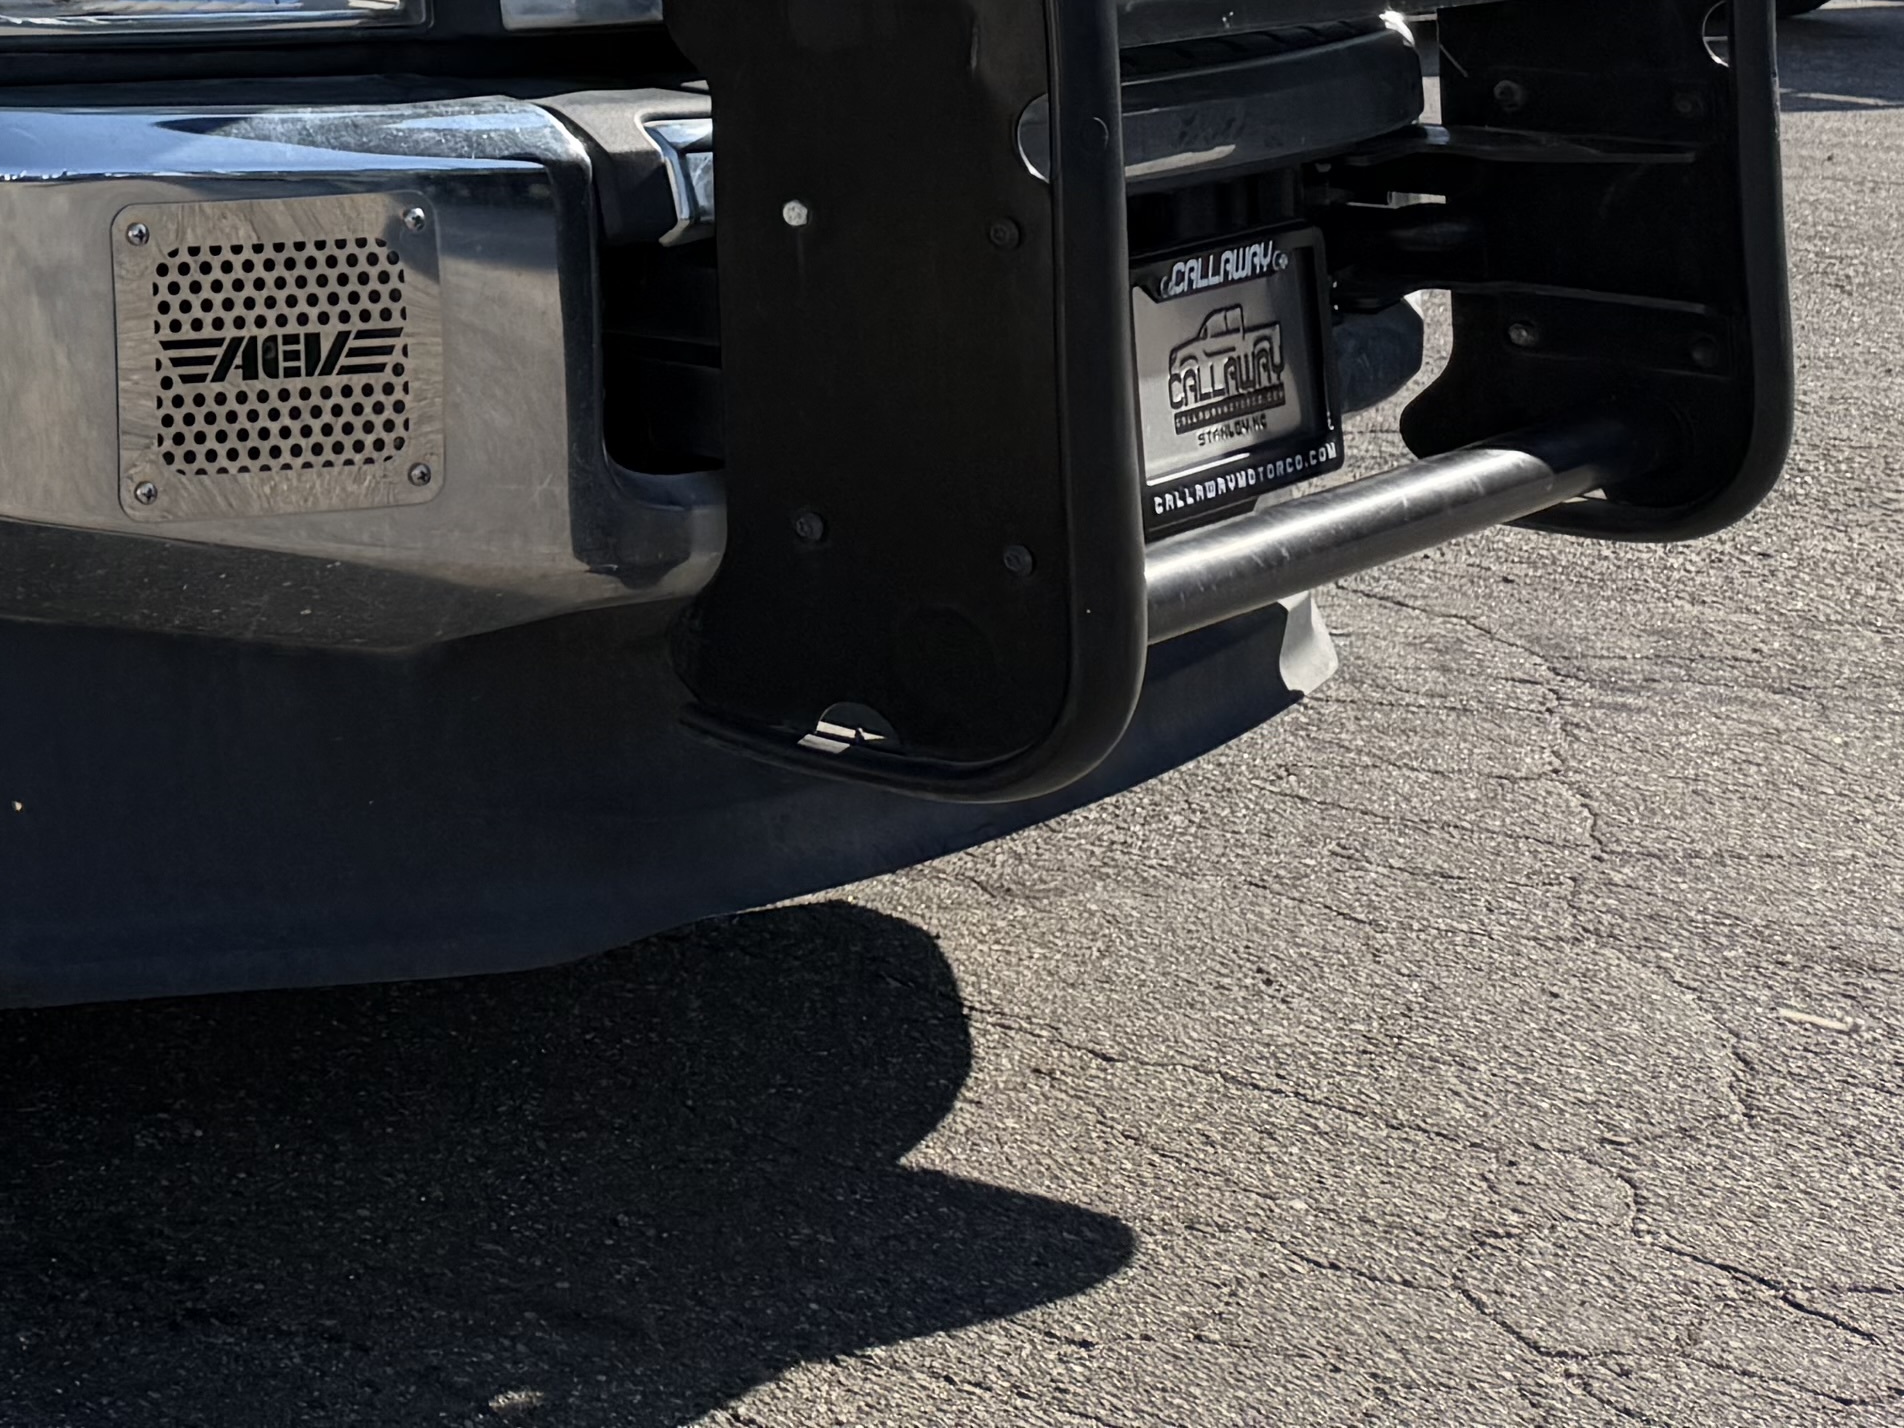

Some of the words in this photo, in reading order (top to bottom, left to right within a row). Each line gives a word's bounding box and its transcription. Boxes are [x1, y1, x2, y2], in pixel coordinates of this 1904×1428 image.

[1170, 240, 1274, 292] CALLAWAY
[1168, 341, 1285, 410] CALLAWAY
[1153, 441, 1338, 515] CALLAWAYMOTORCO.COM
